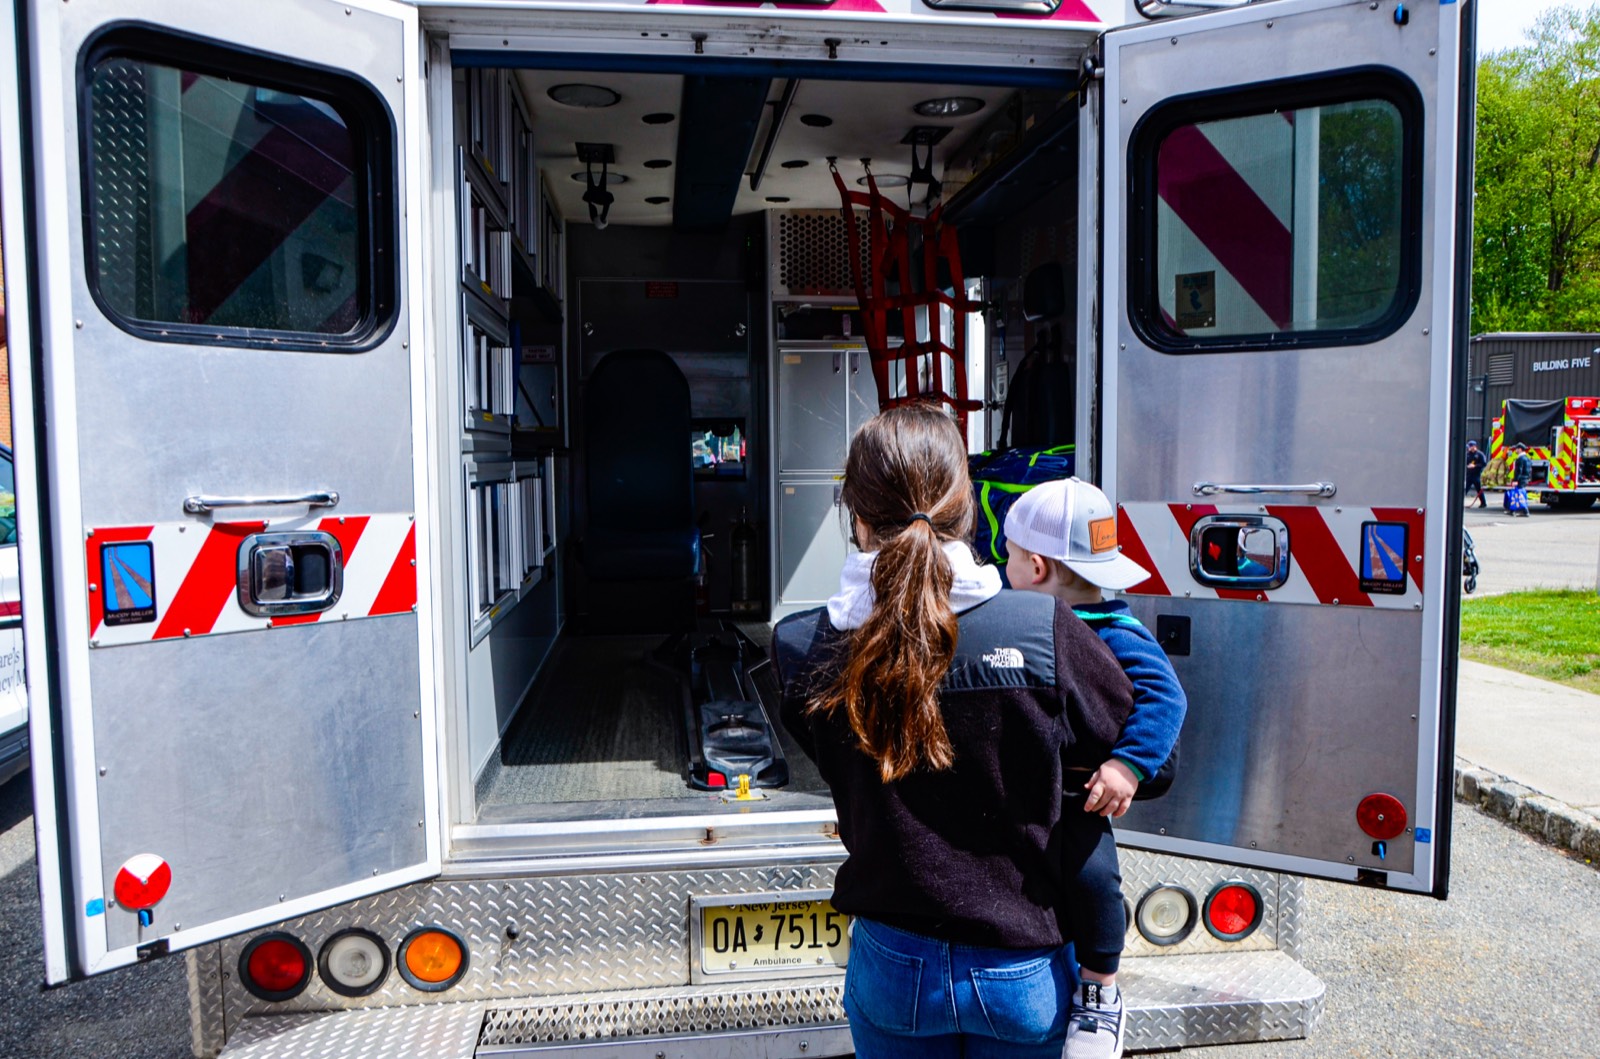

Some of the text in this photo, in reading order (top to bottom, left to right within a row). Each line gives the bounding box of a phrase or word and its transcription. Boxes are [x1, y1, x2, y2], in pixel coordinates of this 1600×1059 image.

[1533, 357, 1591, 372] BUILDING FIVE
[131, 609, 154, 617] MILLER
[982, 654, 1009, 662] NORTH
[739, 900, 813, 914] New Jersey
[770, 912, 842, 950] 7515
[753, 957, 803, 966] Ambulance
